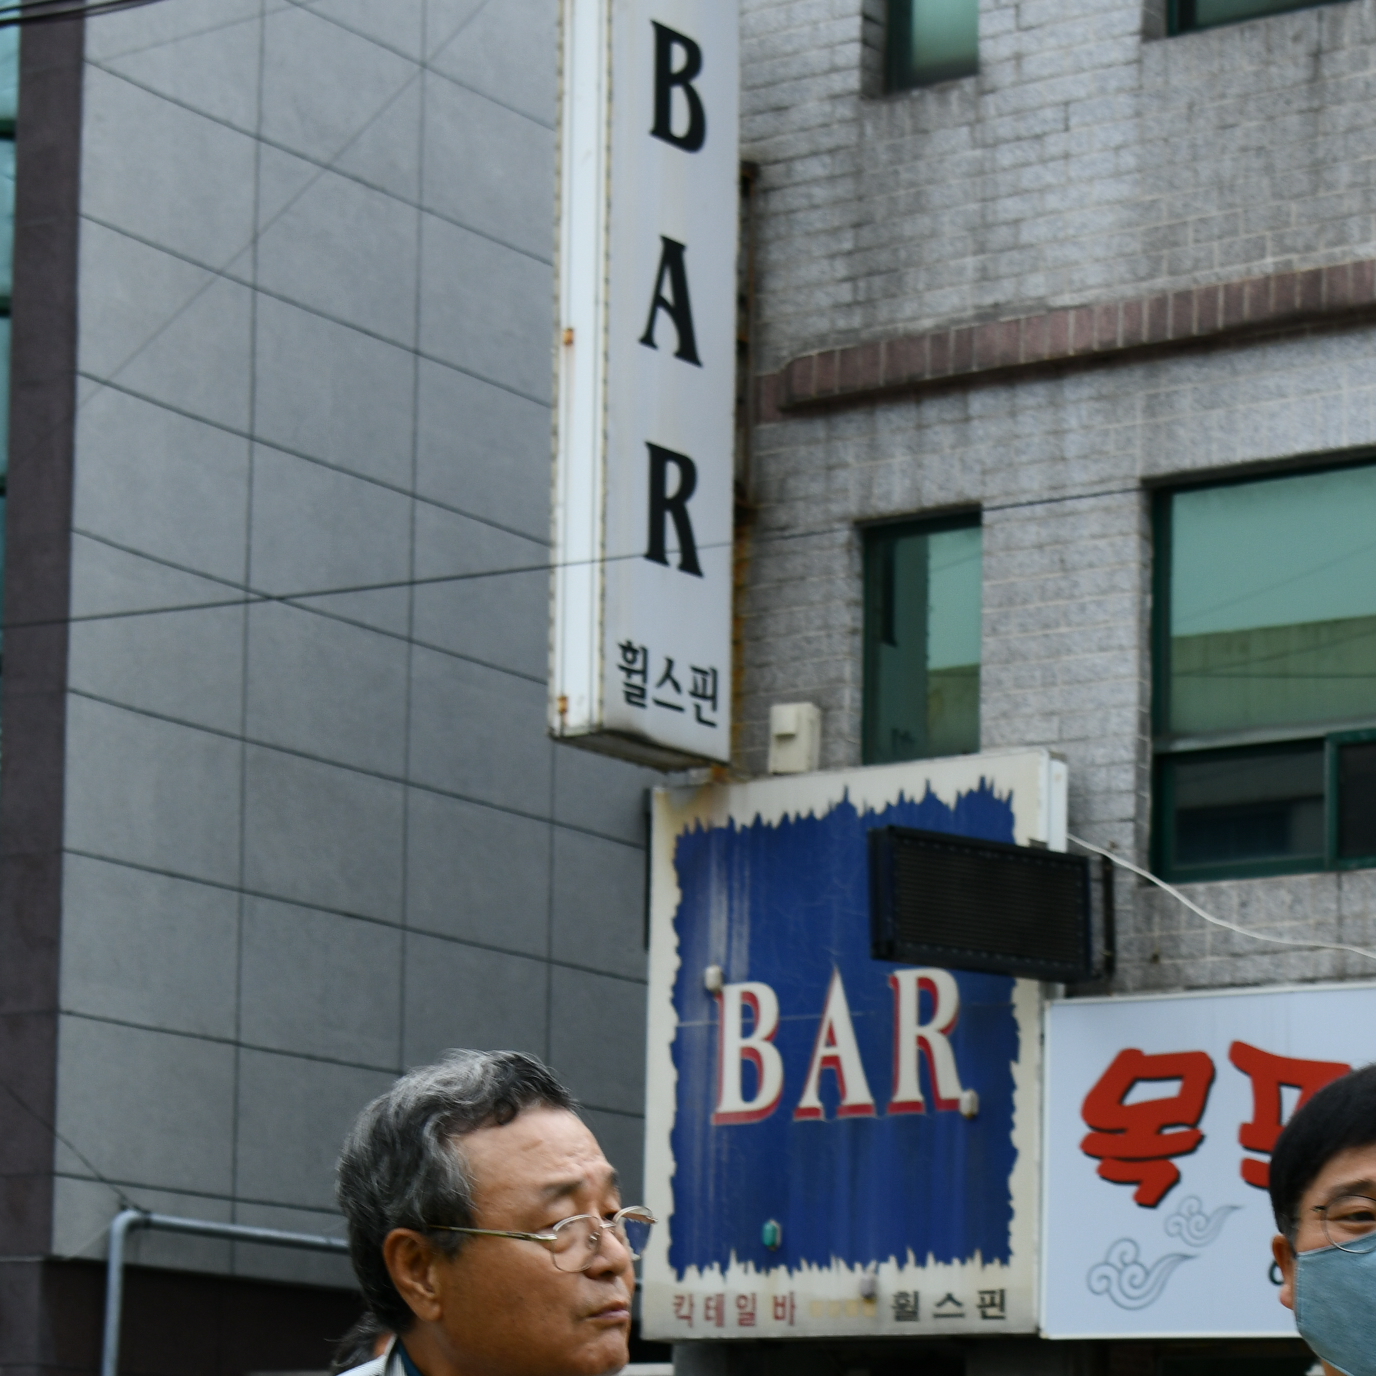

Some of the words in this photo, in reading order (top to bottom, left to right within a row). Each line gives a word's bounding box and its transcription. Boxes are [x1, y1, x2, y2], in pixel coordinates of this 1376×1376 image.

[638, 20, 707, 579] BAR
[616, 639, 717, 728] 휠스핀
[710, 964, 964, 1125] BAR
[891, 1289, 1008, 1322] 휠스핀
